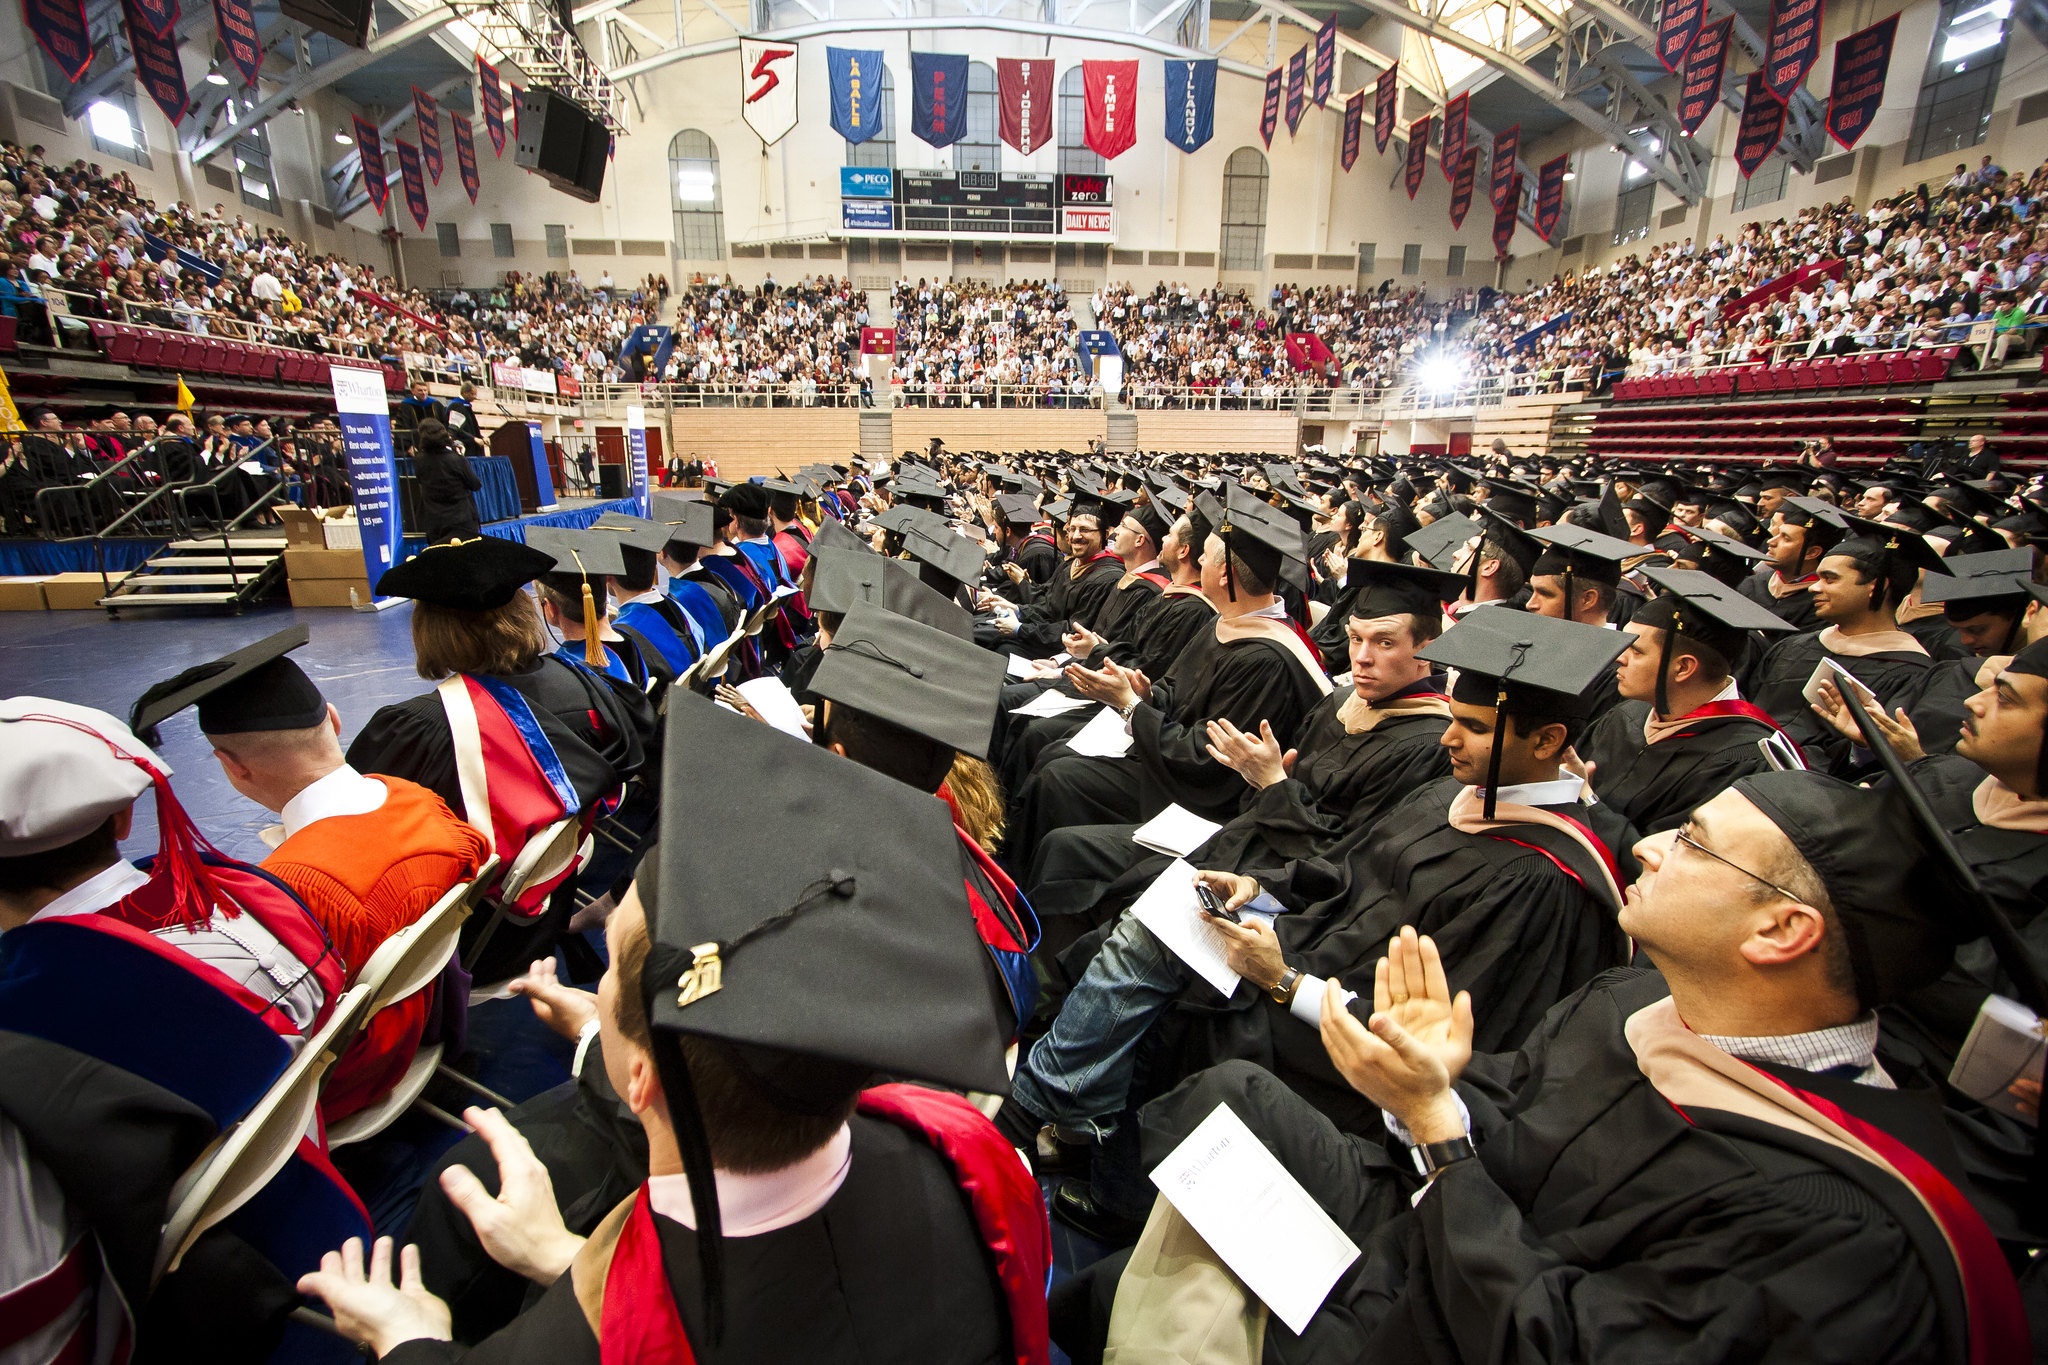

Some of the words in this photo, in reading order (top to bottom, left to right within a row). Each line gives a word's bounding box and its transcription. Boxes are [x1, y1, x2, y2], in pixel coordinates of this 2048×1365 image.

[1775, 59, 1802, 87] 1985
[933, 71, 946, 133] PENN
[1104, 74, 1117, 133] TEMPLE
[1185, 61, 1197, 145] VILLANOVA
[864, 174, 889, 184] PECO
[1065, 175, 1105, 193] Coke
[1071, 191, 1099, 201] zero
[1066, 213, 1088, 230] DAILY
[1088, 214, 1110, 230] NEWS
[348, 380, 382, 398] Wharton
